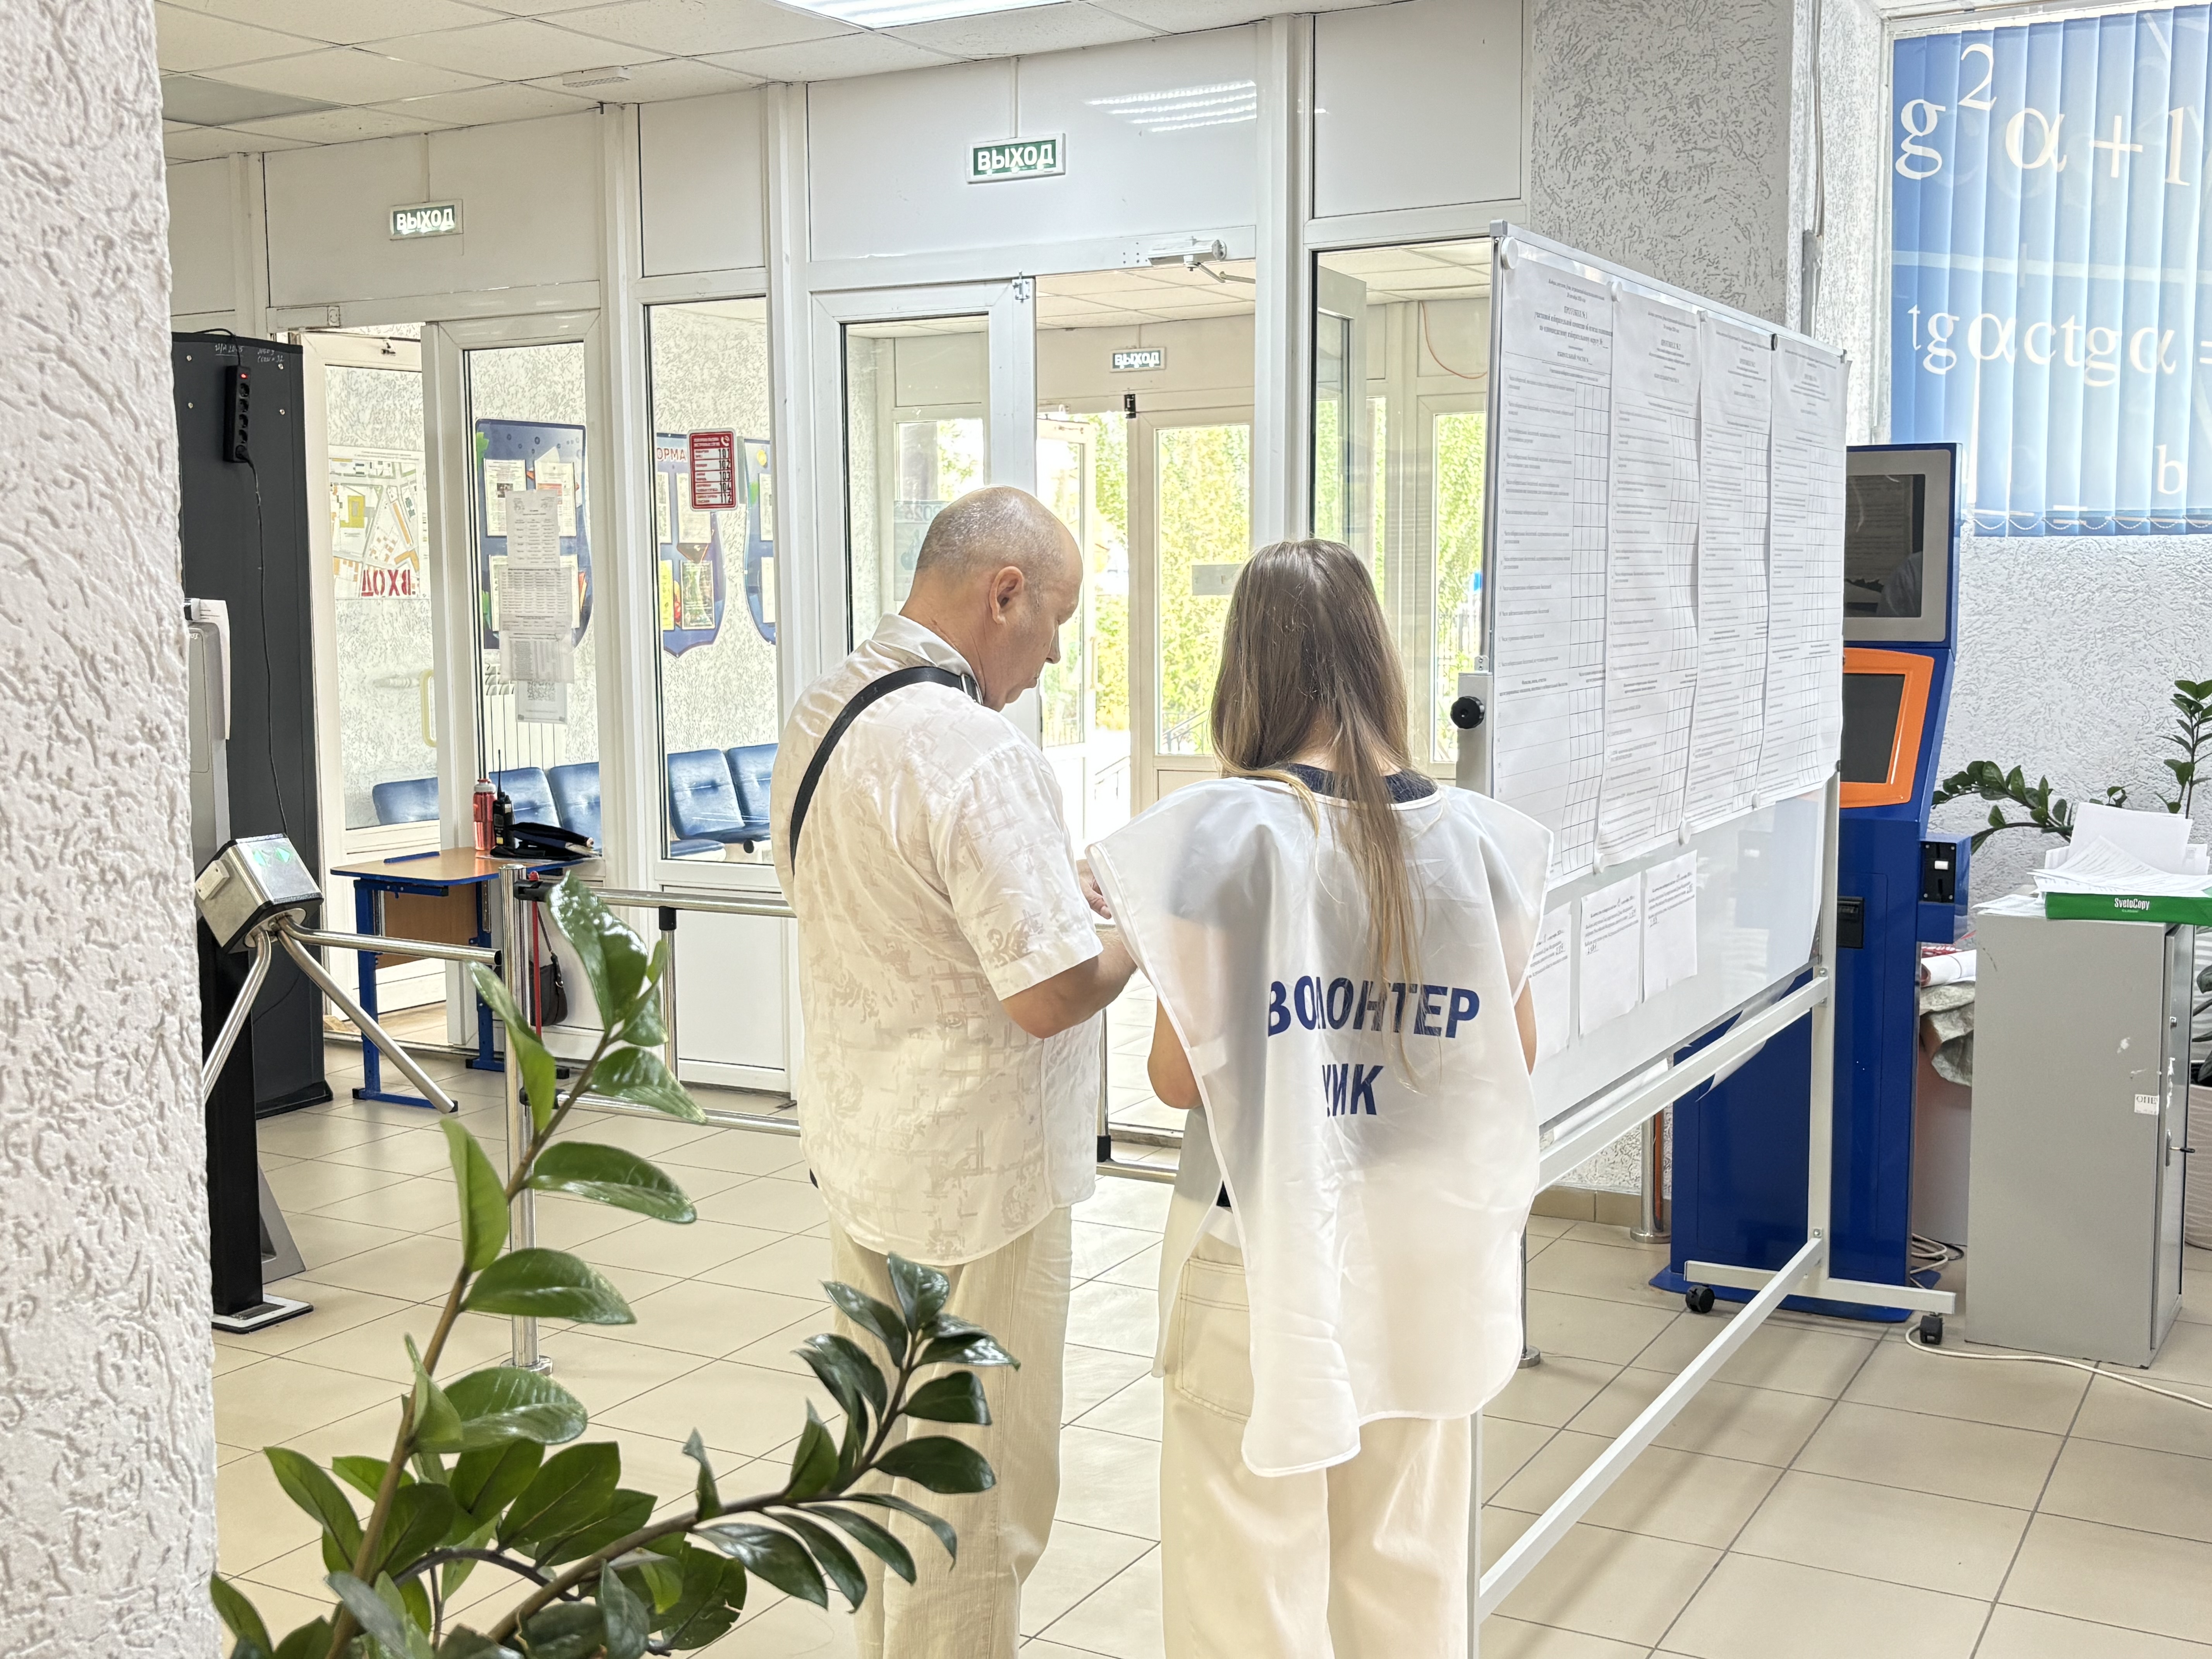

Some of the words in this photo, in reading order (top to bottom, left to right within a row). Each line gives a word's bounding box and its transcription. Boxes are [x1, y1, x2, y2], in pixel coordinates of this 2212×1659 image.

[978, 144, 1054, 171] ВЫХОД
[397, 208, 455, 231] ВЫХОД
[1115, 352, 1160, 366] ВЫХОД
[718, 448, 730, 459] 101
[719, 460, 731, 469] 102
[720, 471, 731, 481] 103
[720, 483, 731, 492] 104
[720, 493, 732, 503] 112
[2114, 898, 2150, 910] SvetoCopy
